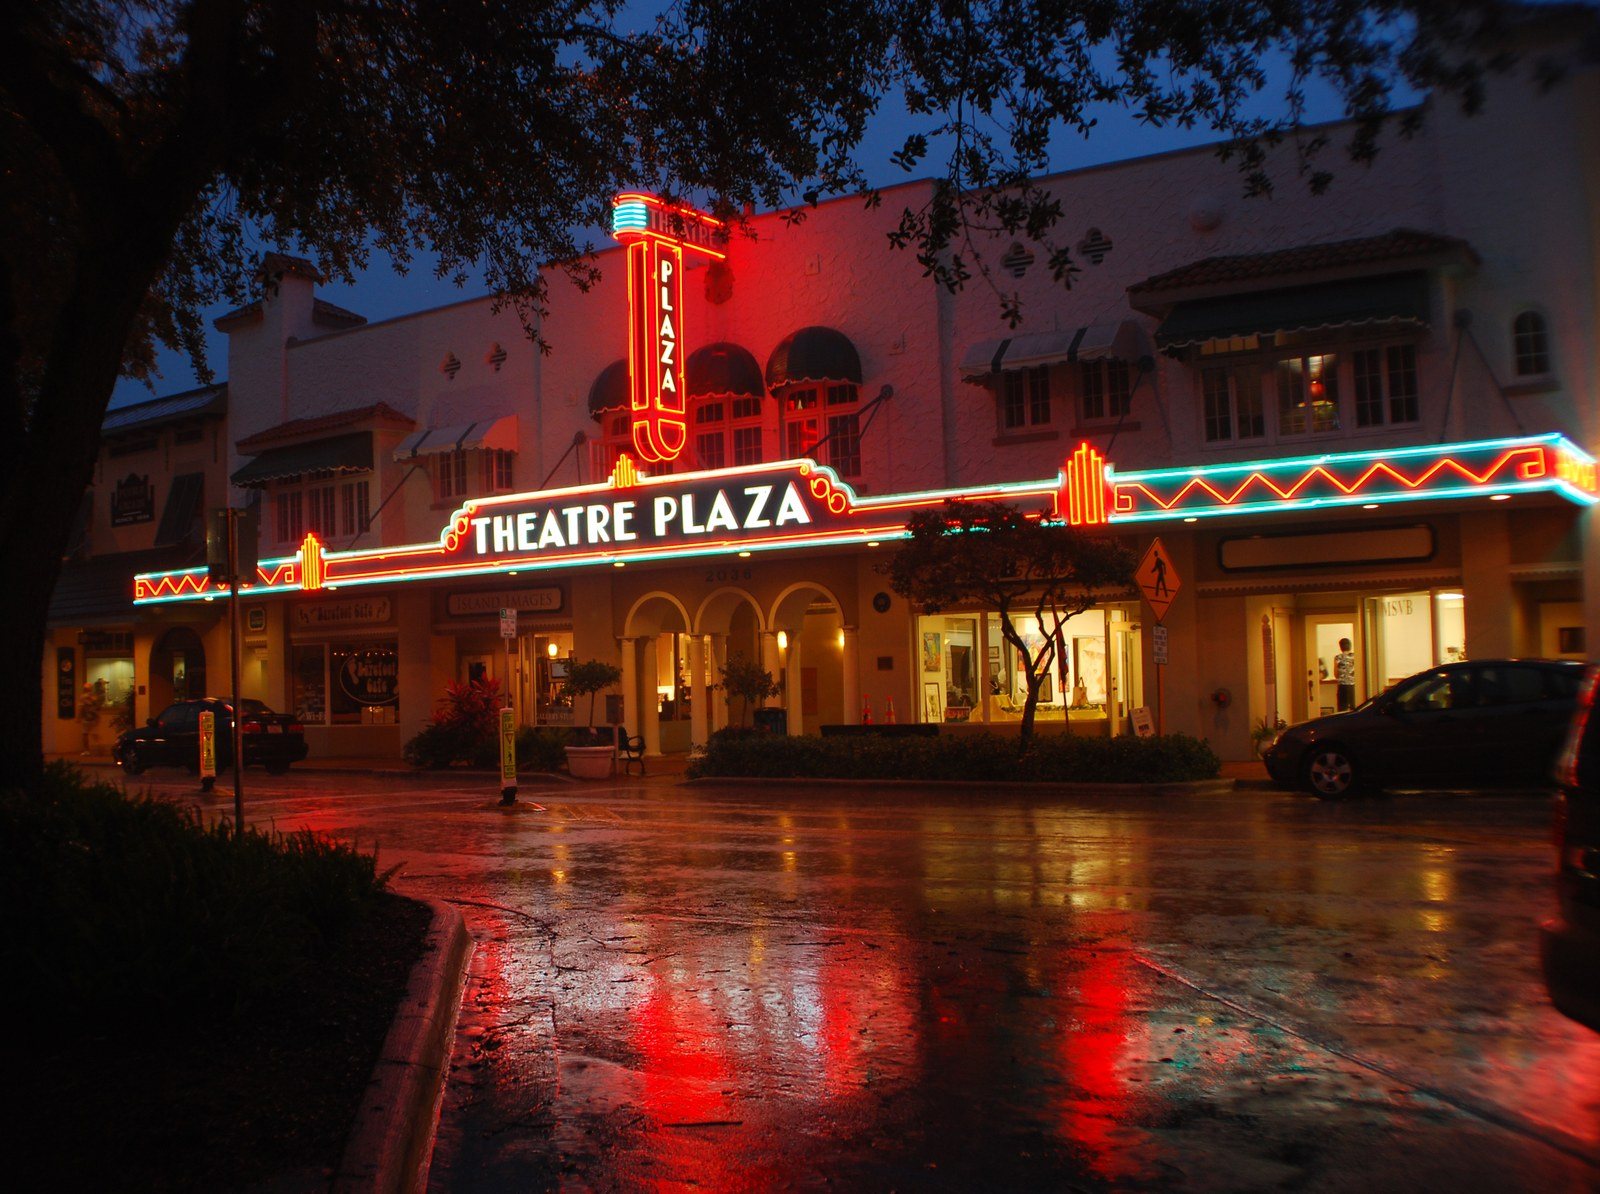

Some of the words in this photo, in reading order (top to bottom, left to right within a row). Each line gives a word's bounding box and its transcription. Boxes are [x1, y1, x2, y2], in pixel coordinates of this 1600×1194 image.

[660, 260, 676, 393] PLAZA
[472, 502, 637, 554] THEATRE
[654, 482, 811, 537] PLAZA
[456, 597, 500, 610] ISLAND
[505, 592, 552, 608] IMAGES
